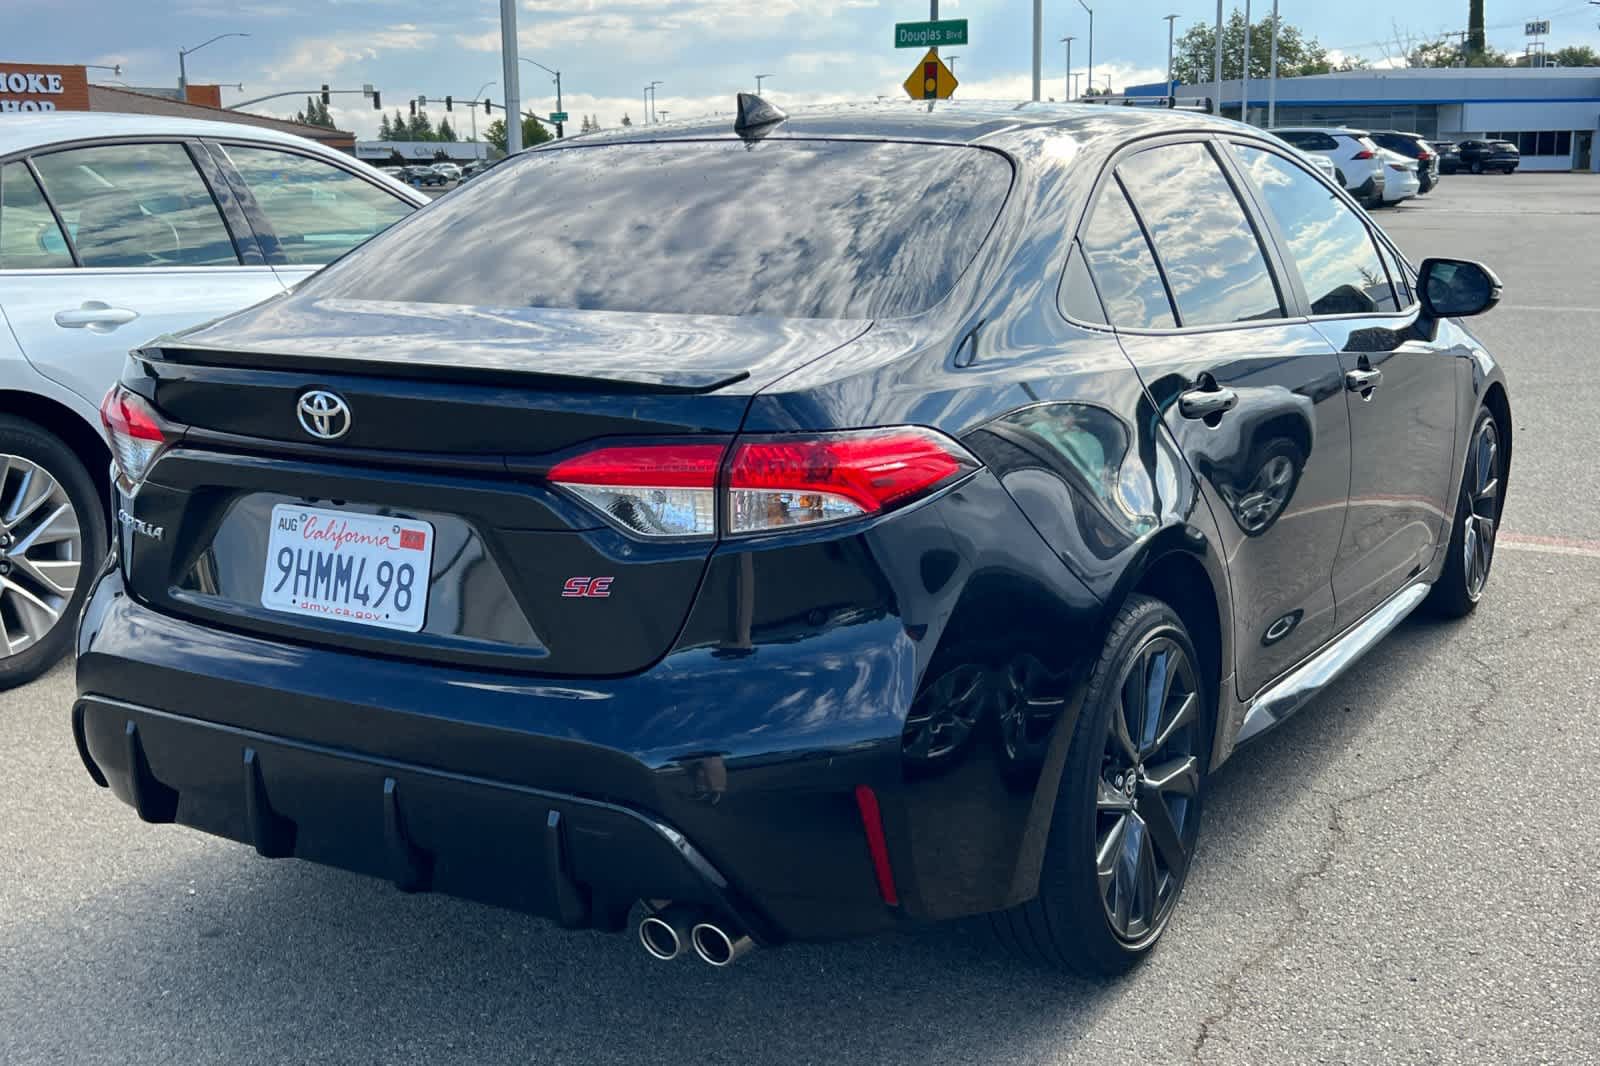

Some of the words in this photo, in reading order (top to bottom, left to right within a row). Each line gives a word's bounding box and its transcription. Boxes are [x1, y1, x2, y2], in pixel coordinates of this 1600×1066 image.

[900, 28, 941, 45] Douglas
[946, 30, 962, 39] Blvd
[278, 517, 298, 532] AUG
[303, 516, 401, 550] California
[274, 546, 415, 612] 9HMM498
[561, 576, 615, 597] SE
[301, 601, 381, 621] dmv.ca.gov
